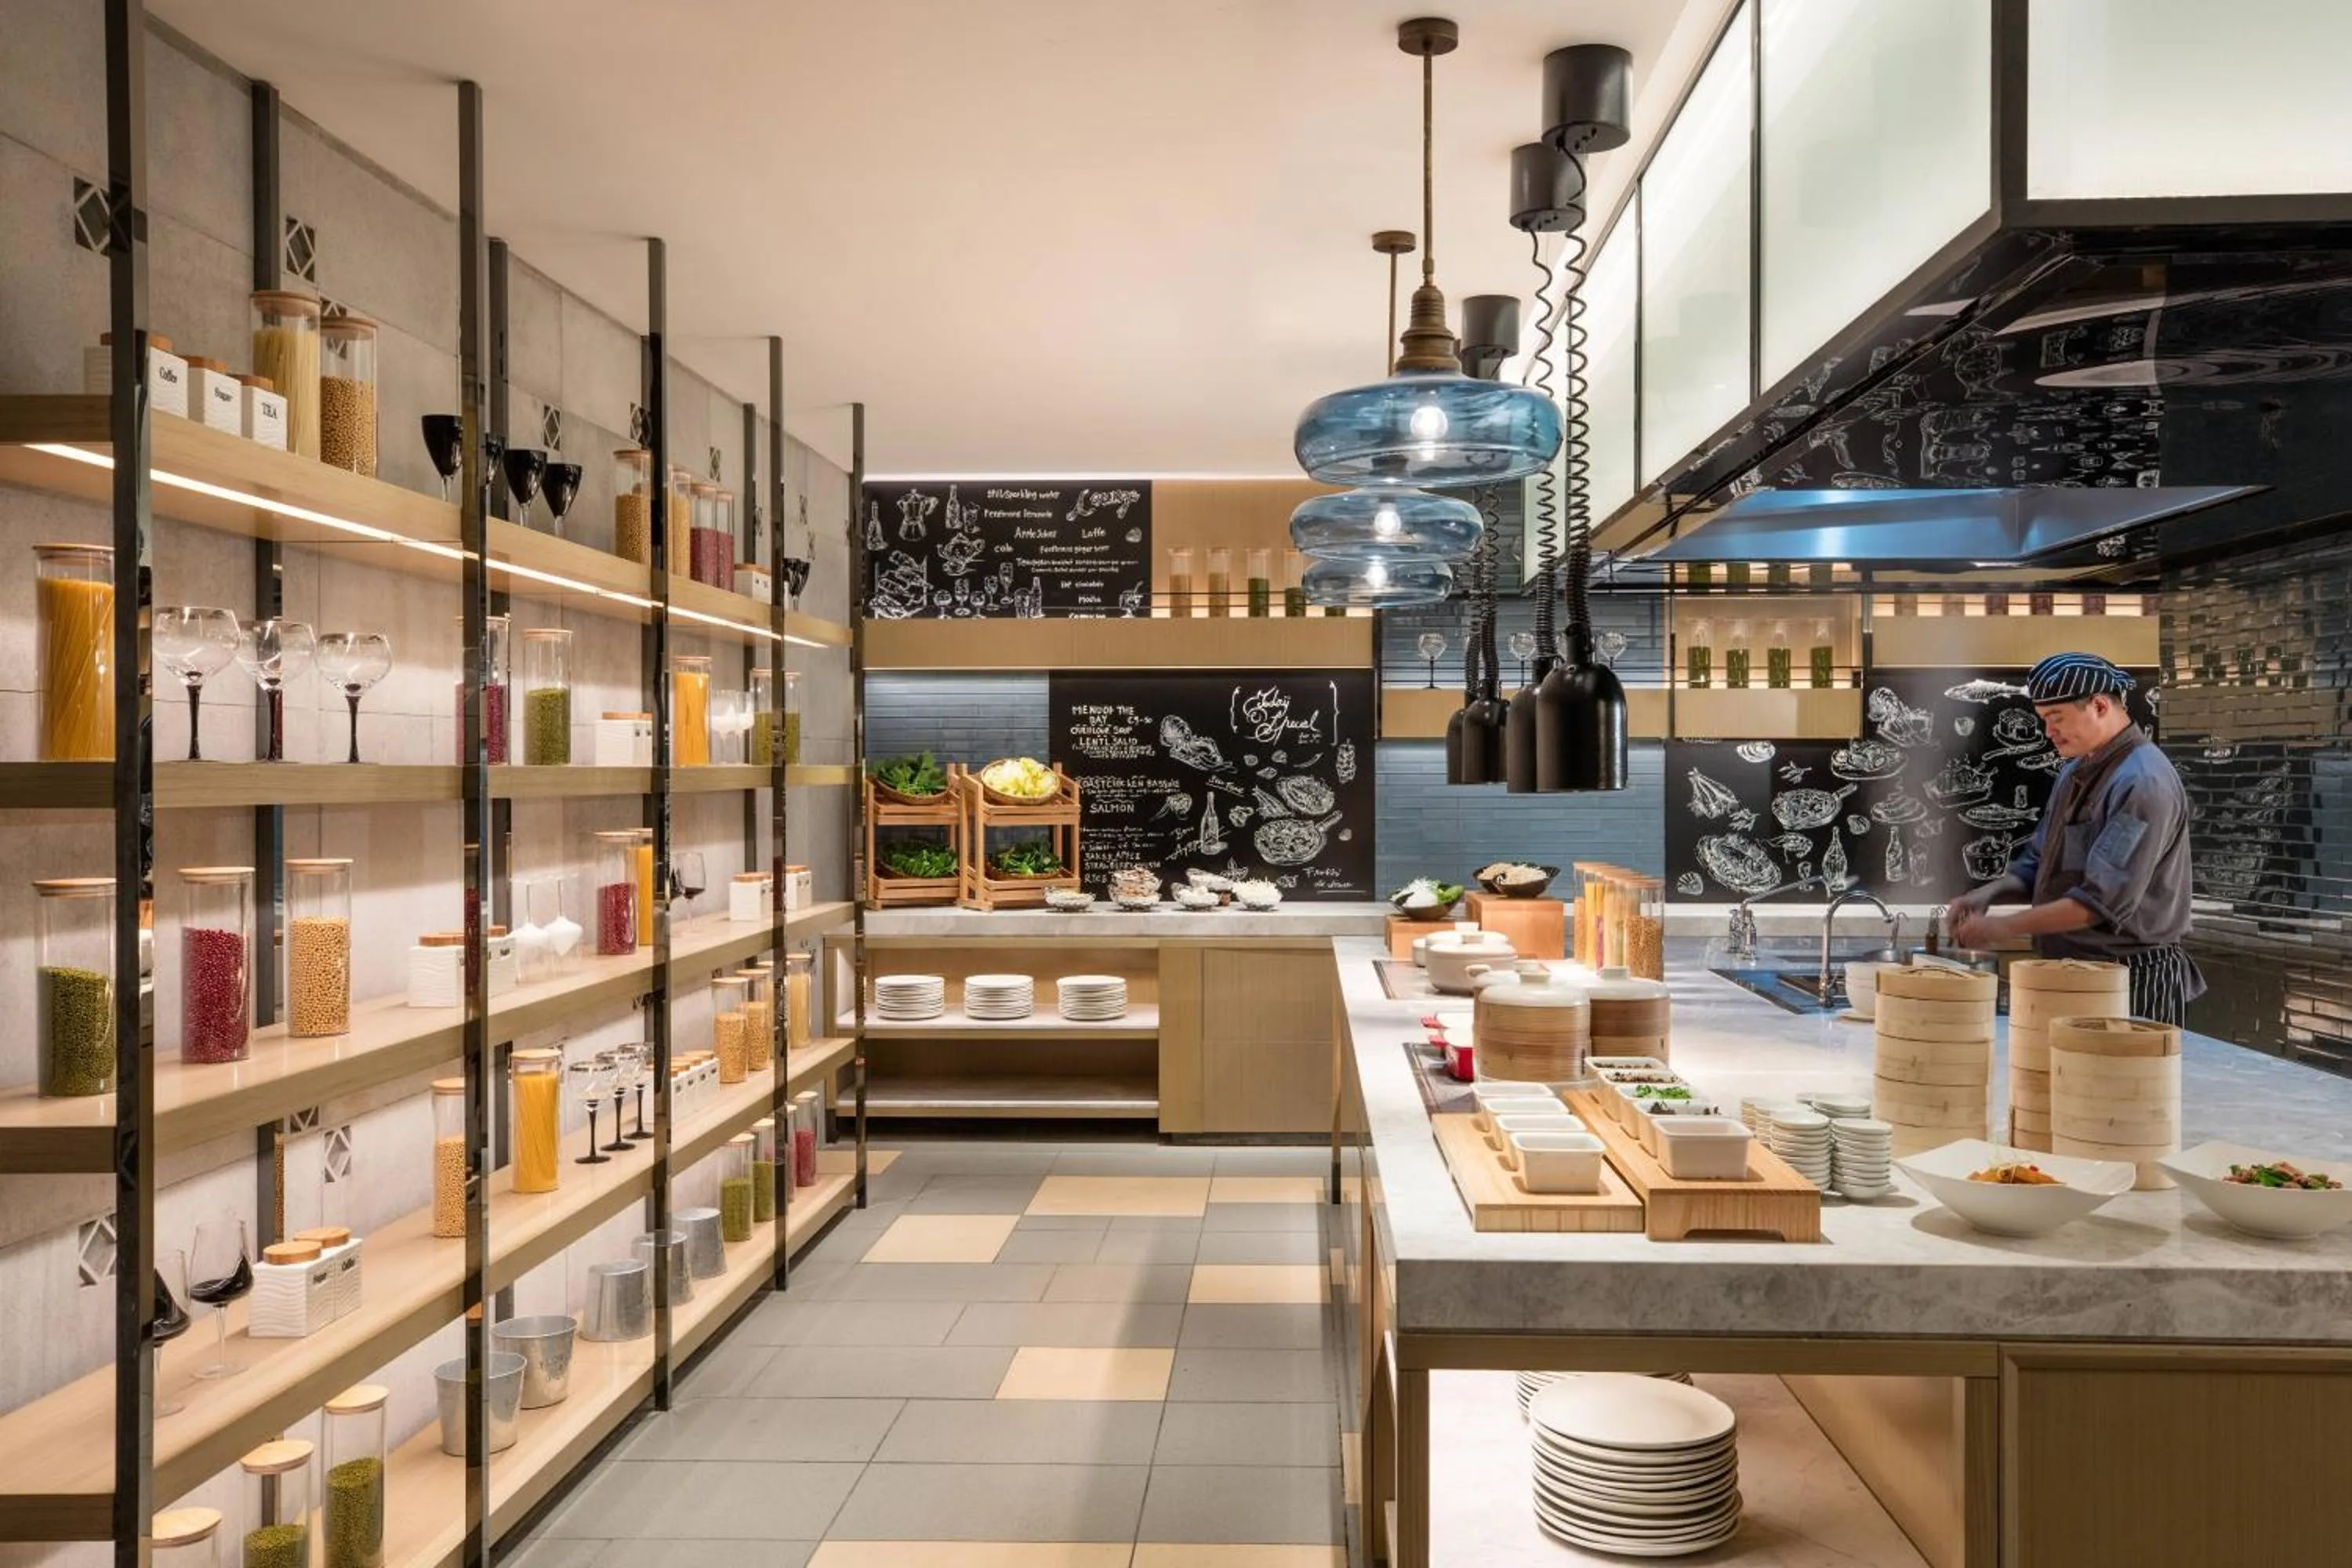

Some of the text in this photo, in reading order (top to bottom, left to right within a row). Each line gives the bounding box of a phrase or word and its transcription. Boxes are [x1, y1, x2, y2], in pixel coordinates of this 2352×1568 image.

[261, 402, 278, 419] TEA
[1116, 706, 1135, 715] THE
[1089, 804, 1134, 814] SALMON
